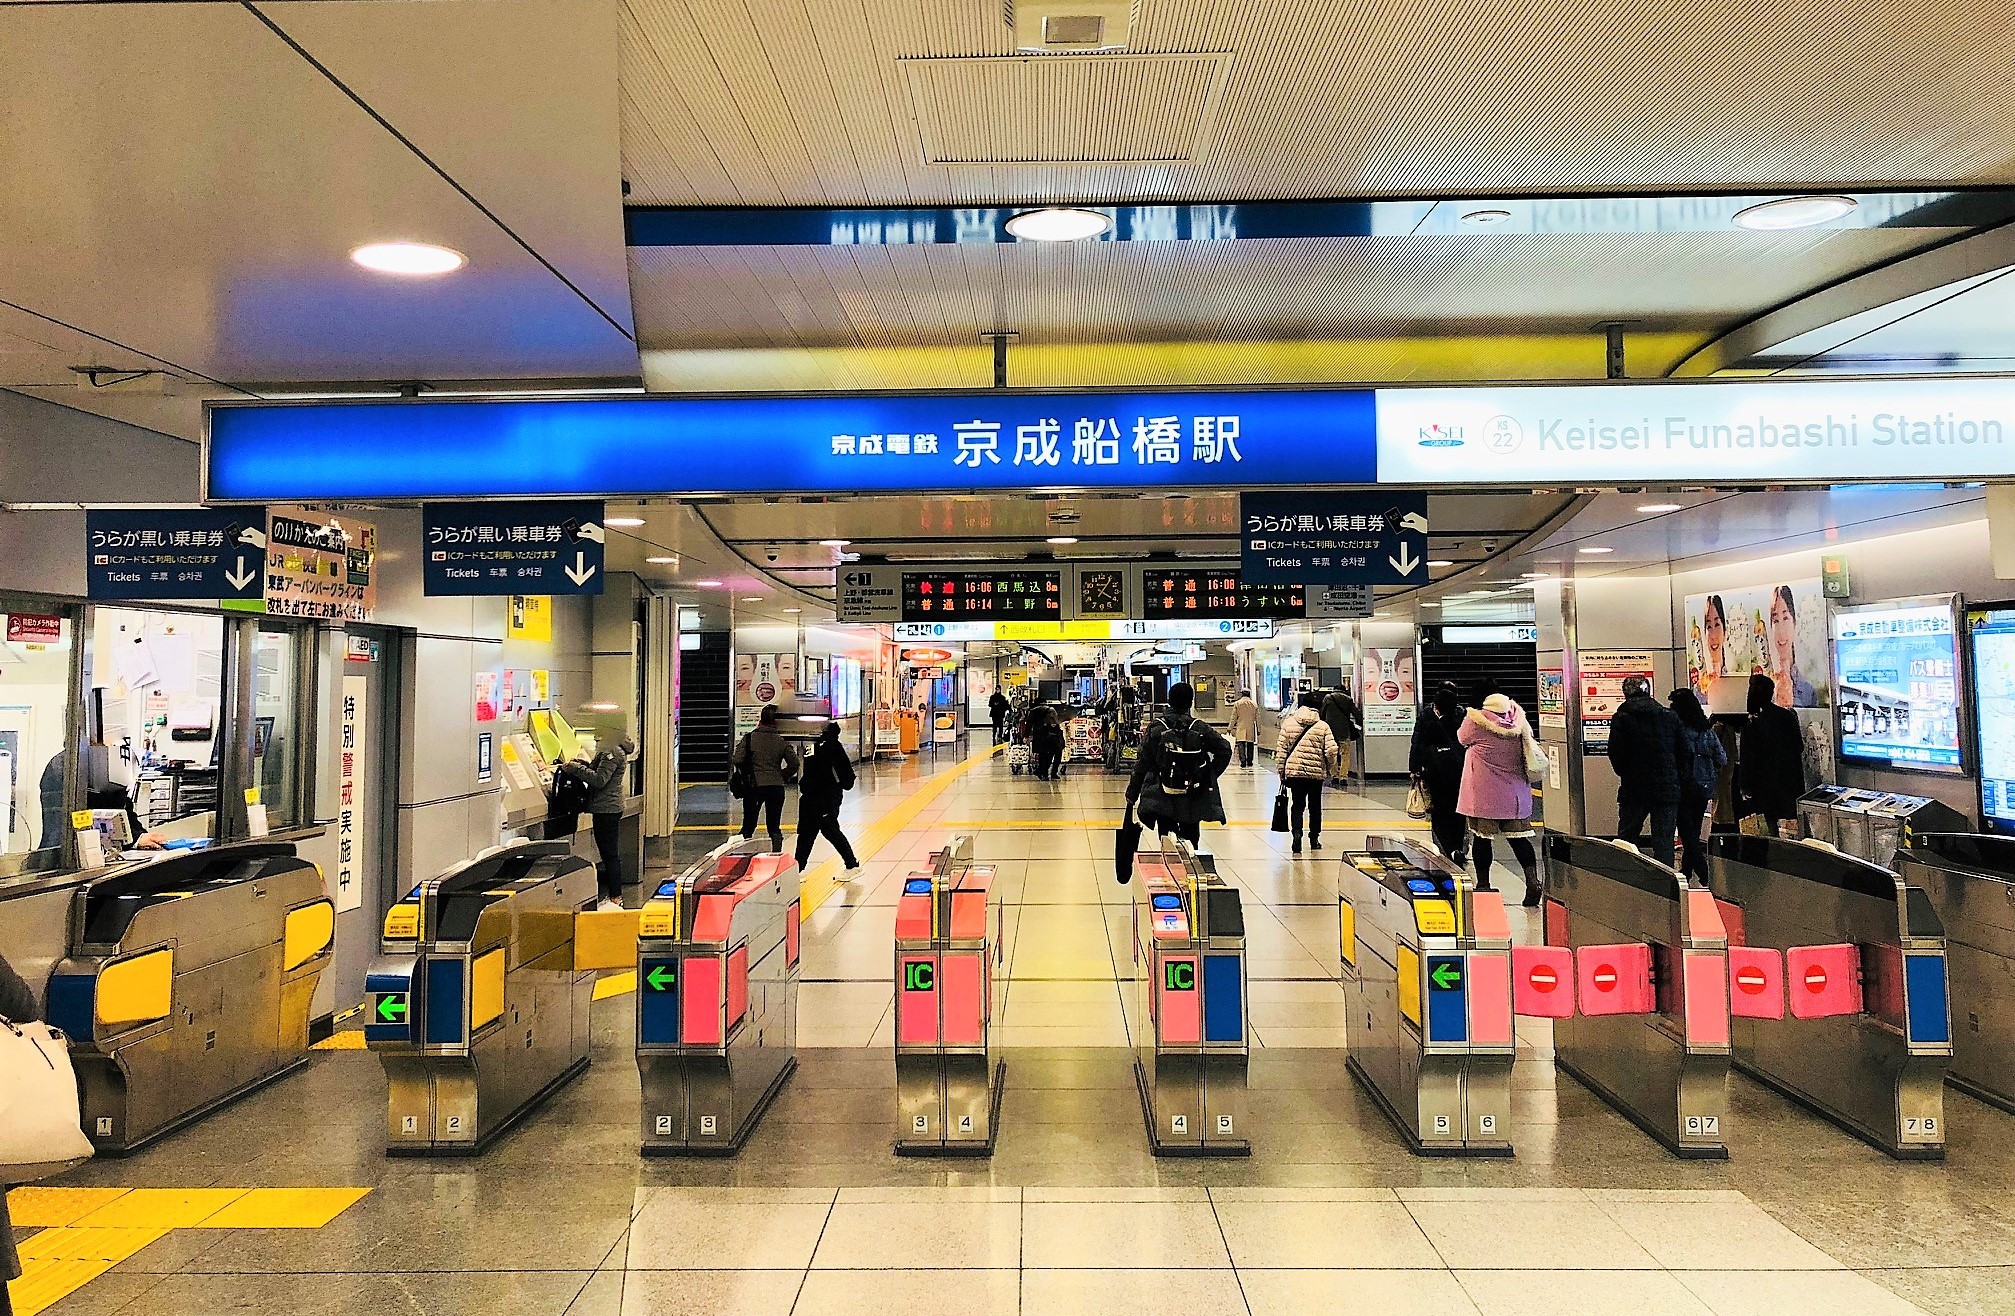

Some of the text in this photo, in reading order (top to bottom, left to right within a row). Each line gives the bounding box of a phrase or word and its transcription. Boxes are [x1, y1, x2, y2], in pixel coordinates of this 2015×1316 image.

[1497, 420, 1508, 431] KS
[1538, 412, 2003, 451] Keisei Funabashi Station
[831, 415, 1243, 467] 京成電鉄 京成船橋駅
[1493, 432, 1513, 447] 22
[1247, 515, 1385, 533] うらが黒い乗車券
[91, 529, 224, 548] うらが黒い乗車券
[428, 526, 562, 543] うらが黒い乗車券
[1268, 541, 1380, 549] ICカードもご利用いただけます
[109, 555, 219, 564] ICカードもご利用いただけます
[270, 553, 285, 569] JR
[447, 551, 557, 560] ICカードもご利用いただけます
[1266, 557, 1301, 567] Tickets
[107, 572, 141, 581] Tickets
[445, 568, 479, 577] Tickets
[965, 581, 992, 593] 16:06
[997, 581, 1041, 593] 西馬込
[1163, 578, 1197, 592] 普通
[1208, 579, 1235, 590] 16:08
[921, 598, 954, 611] 普通
[965, 598, 992, 610] 16:14
[1002, 598, 1036, 610] 上野
[1163, 595, 1197, 609] 普通
[1208, 595, 1236, 607] 16:18
[1241, 595, 1286, 607] うすい
[339, 695, 355, 892] 特別警戒実施中
[906, 963, 933, 989] IC
[1166, 963, 1193, 989] IC
[101, 1117, 108, 1130] 1
[406, 1117, 413, 1128] 1
[450, 1117, 459, 1128] 2
[659, 1117, 668, 1128] 2
[704, 1117, 713, 1128] 3
[916, 1117, 925, 1127] 3
[962, 1117, 971, 1127] 4
[1174, 1117, 1184, 1127] 4
[1220, 1117, 1229, 1127] 5
[1437, 1117, 1446, 1127] 5
[1483, 1117, 1492, 1127] 6
[1688, 1117, 1698, 1129] 6
[1705, 1117, 1715, 1129] 7
[1907, 1119, 1917, 1130] 7
[1924, 1119, 1934, 1130] 8
